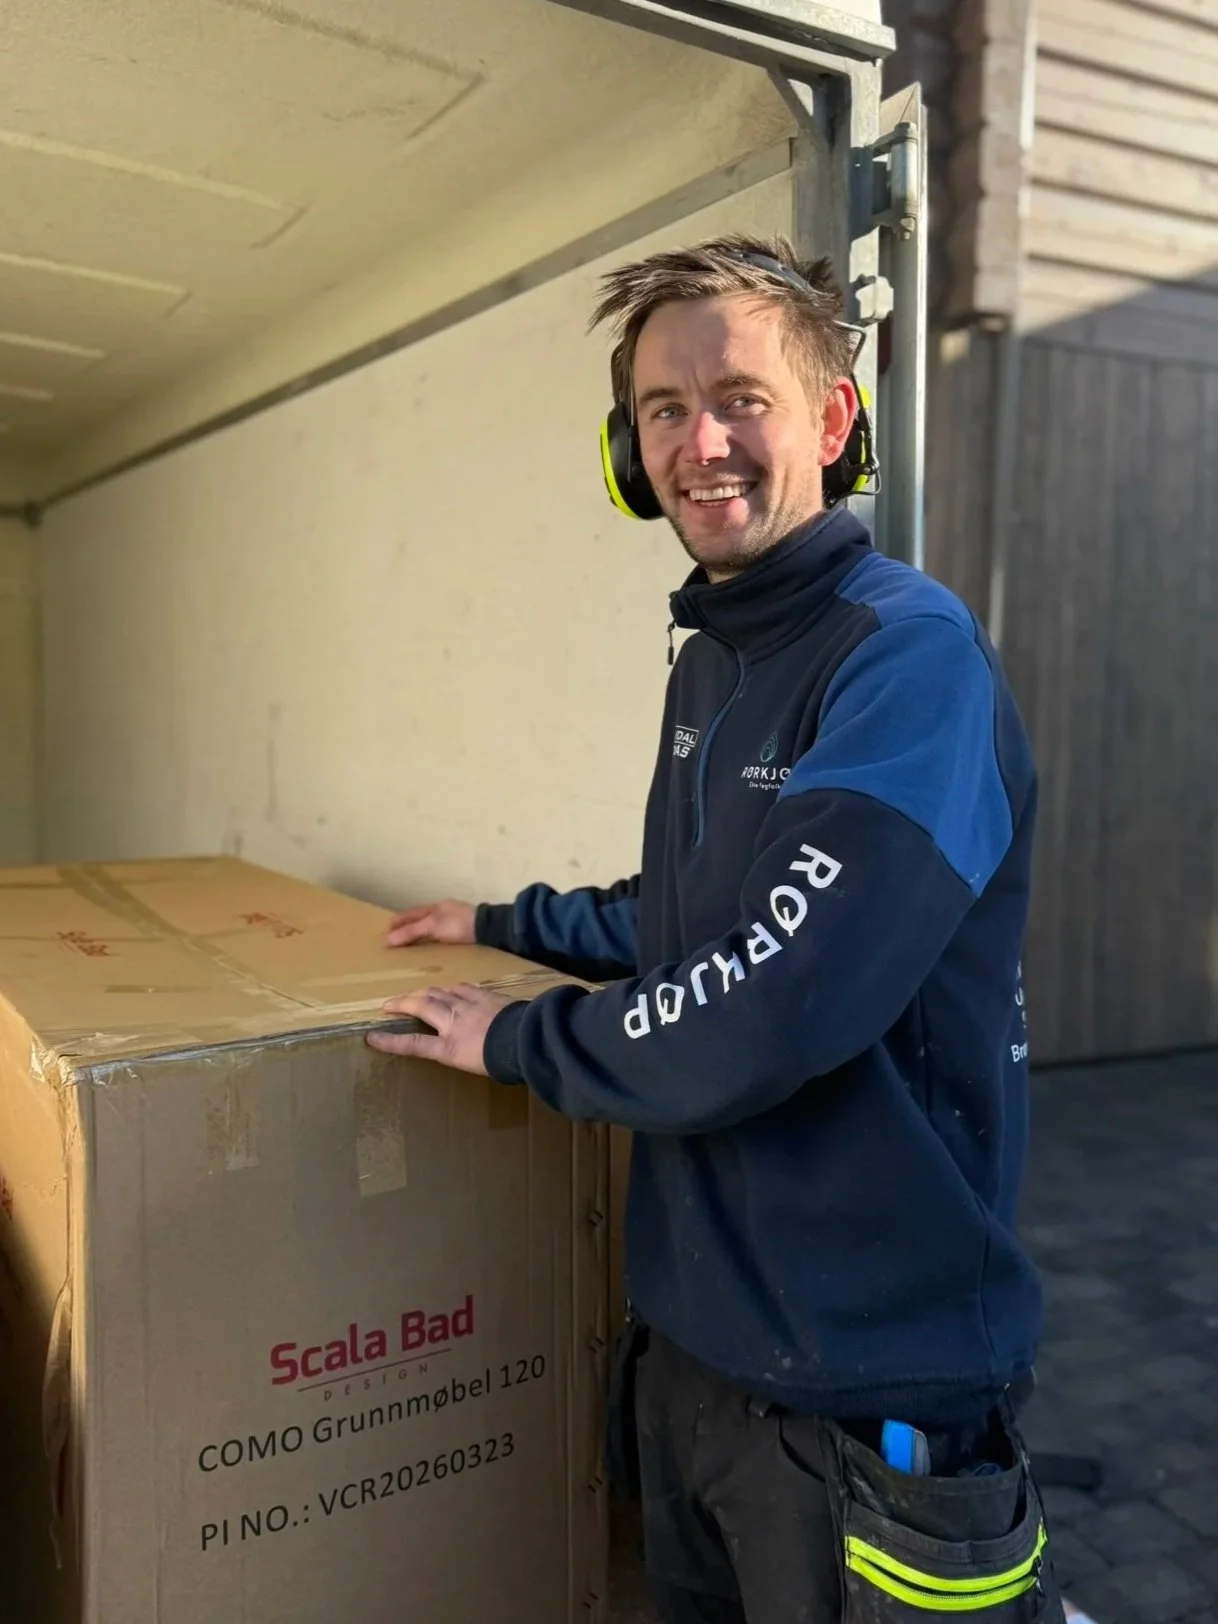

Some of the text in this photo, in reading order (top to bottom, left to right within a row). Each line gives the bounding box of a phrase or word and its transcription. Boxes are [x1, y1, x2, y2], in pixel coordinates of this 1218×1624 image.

[675, 730, 695, 744] DAL
[741, 766, 791, 780] RØRKJØ
[624, 843, 843, 1039] RØRKJØP
[270, 1294, 474, 1385] Scala Bad
[323, 1363, 428, 1402] DESIGN
[198, 1354, 546, 1473] COMO Grunnmøbel 120
[201, 1432, 515, 1550] PI NO.: VCR20260323
